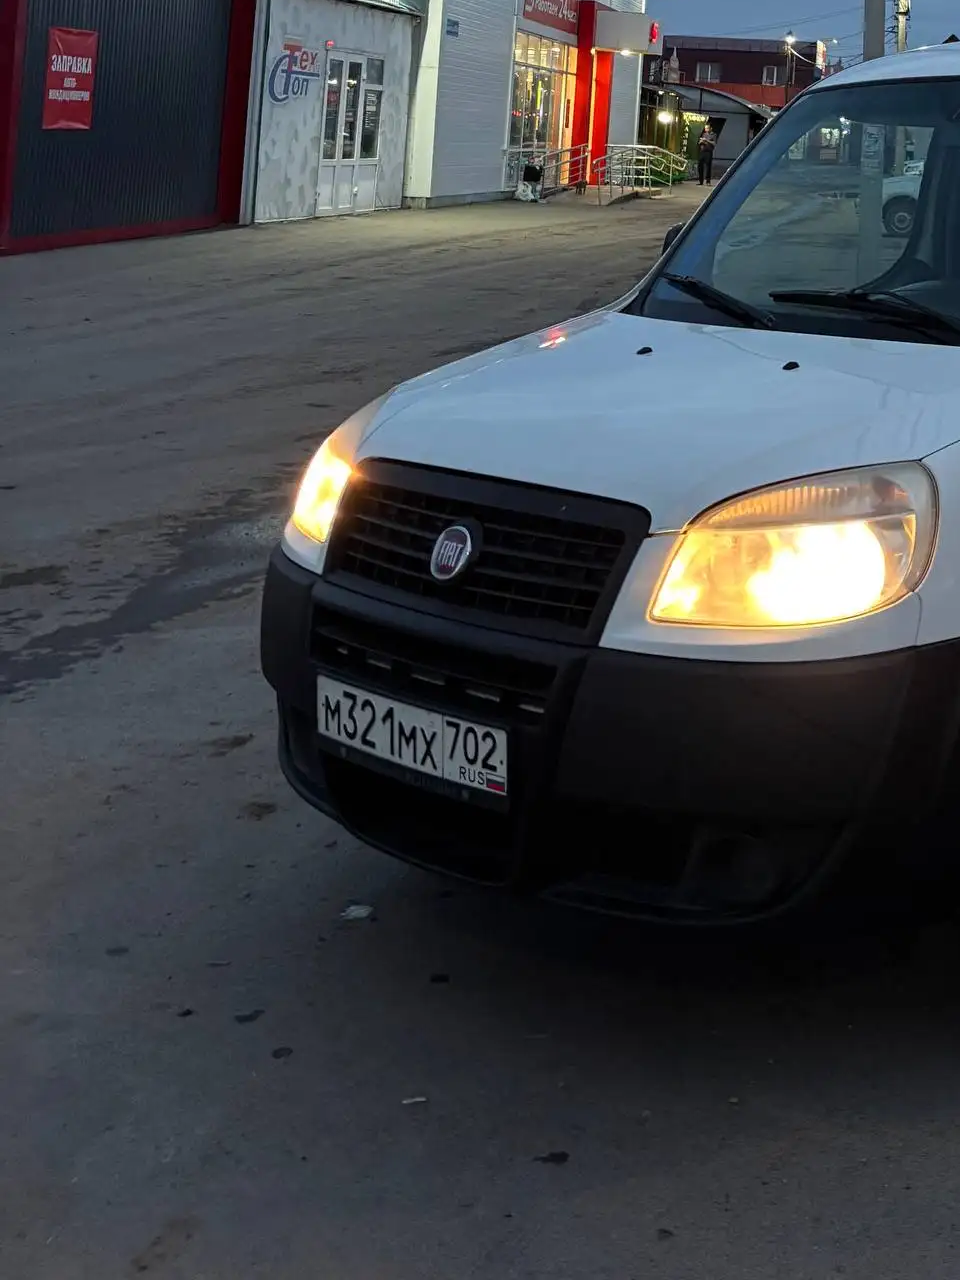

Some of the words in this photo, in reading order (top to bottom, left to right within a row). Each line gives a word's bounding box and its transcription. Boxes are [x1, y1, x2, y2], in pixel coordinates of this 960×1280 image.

[51, 54, 92, 73] ЗАПРАВКА
[438, 540, 464, 567] FIAT
[446, 720, 498, 772] 702
[459, 766, 486, 786] RUS
